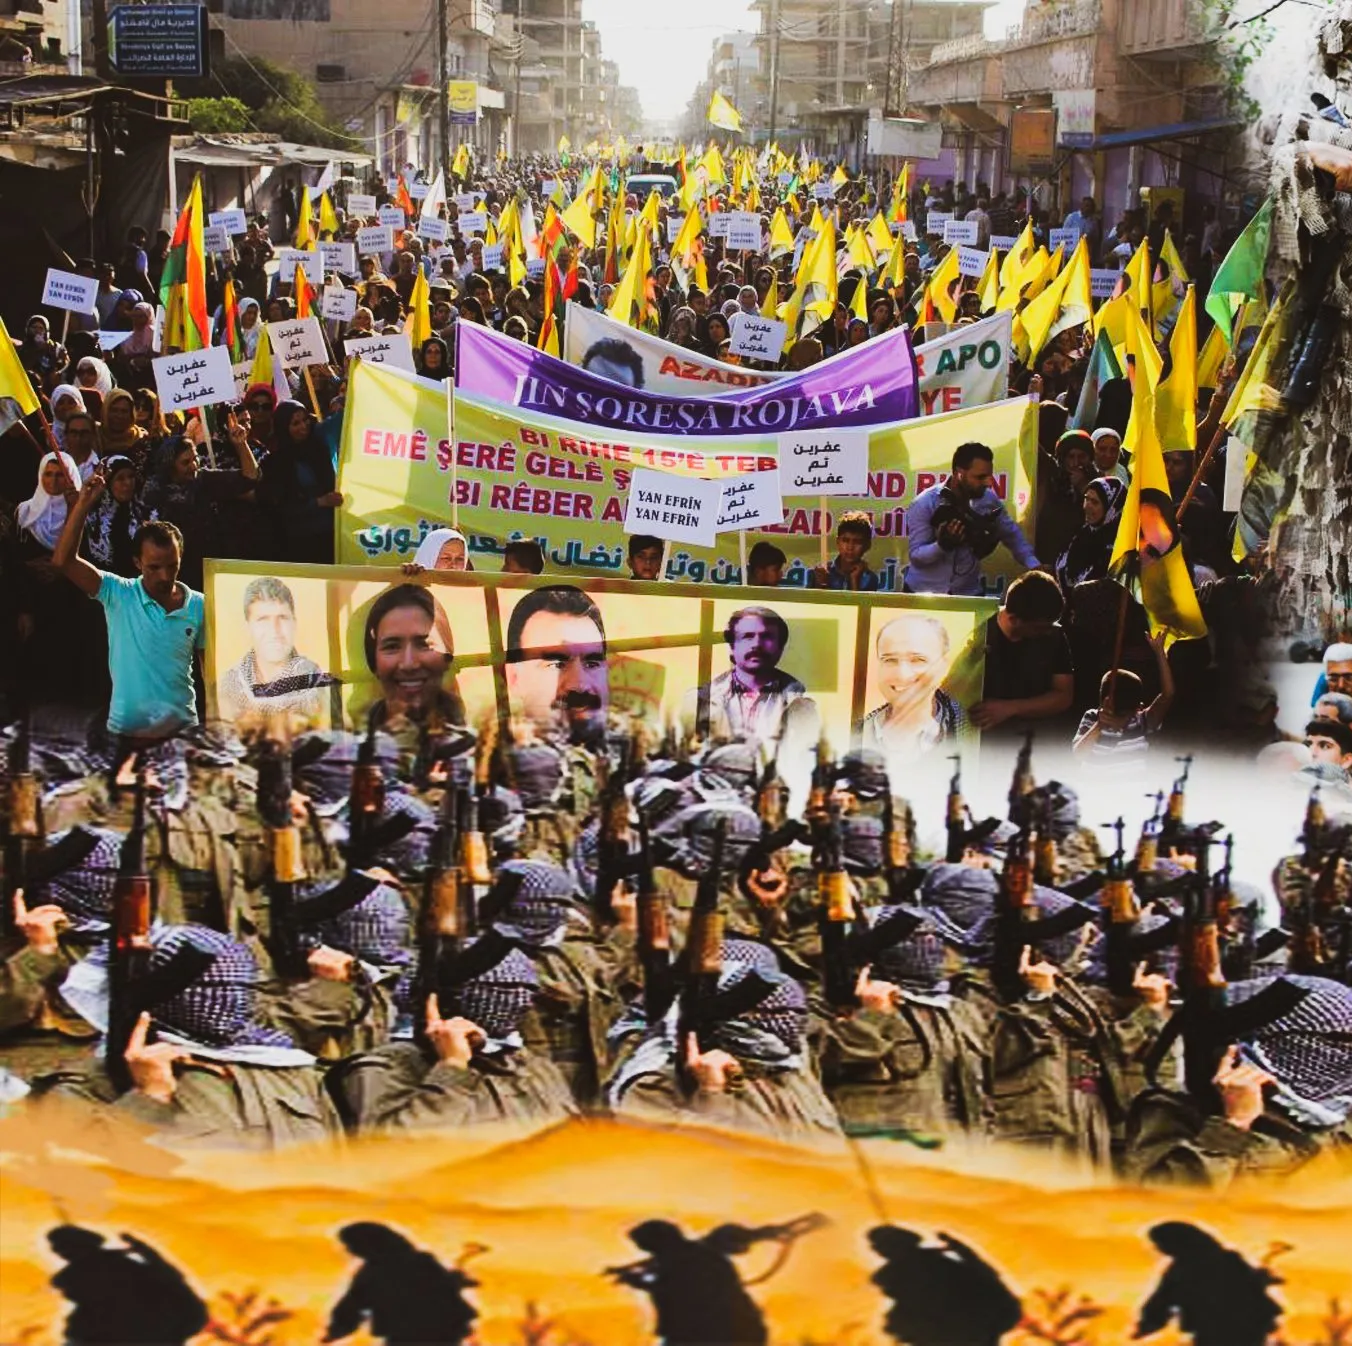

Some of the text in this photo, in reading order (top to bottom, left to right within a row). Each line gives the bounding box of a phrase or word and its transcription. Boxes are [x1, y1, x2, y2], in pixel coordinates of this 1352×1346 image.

[166, 357, 208, 376] عفرين
[935, 339, 1001, 376] APO
[172, 385, 216, 404] عفرين
[513, 373, 567, 409] JIN
[731, 382, 878, 431] ROJAVA
[362, 428, 428, 462] EMÊ
[436, 438, 516, 472] ŞERÊ
[525, 450, 605, 483] GELÊ
[520, 427, 549, 449] BI
[715, 455, 778, 473] TEB
[793, 440, 842, 456] عفرين
[794, 472, 844, 488] عفرين
[449, 479, 481, 507] BI
[490, 481, 593, 520] RÊBER
[637, 489, 702, 511] YAN EFRÎN
[635, 506, 660, 521] YAN
[662, 510, 699, 528] EFRÎN
[716, 508, 760, 526] عفرين
[551, 540, 622, 569] نضال
